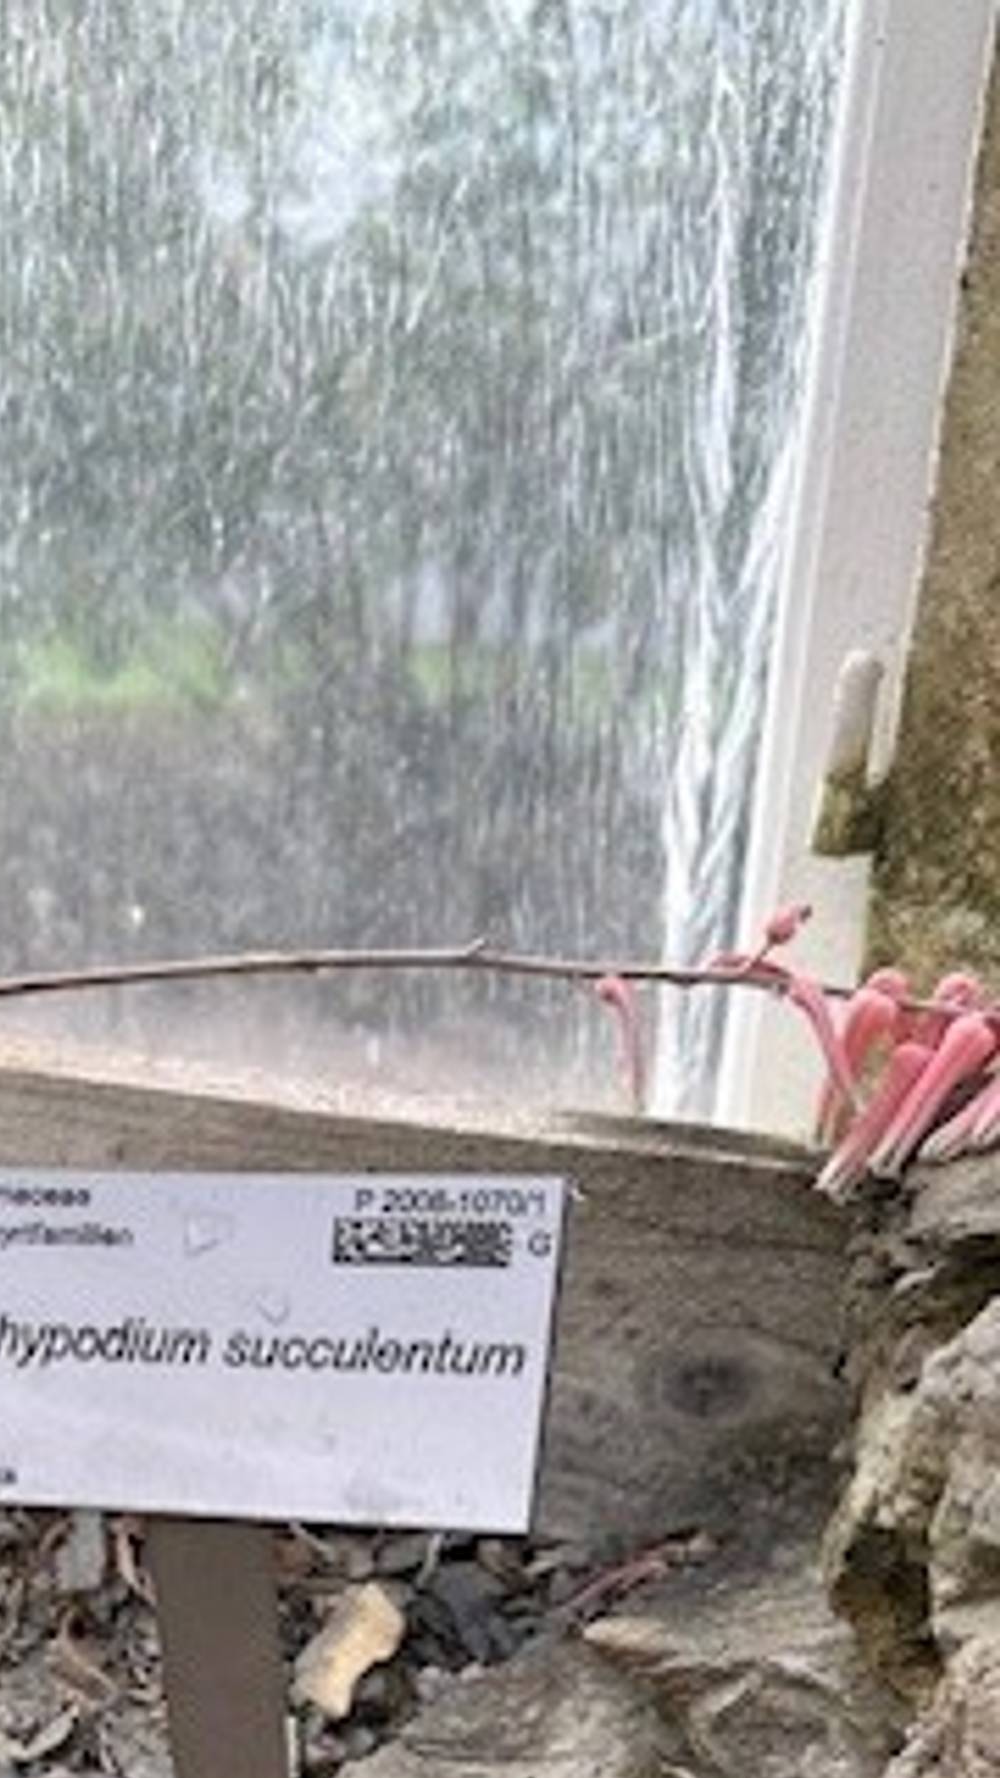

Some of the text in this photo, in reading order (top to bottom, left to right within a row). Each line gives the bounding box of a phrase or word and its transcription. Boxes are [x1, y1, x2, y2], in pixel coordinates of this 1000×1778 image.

[355, 1189, 373, 1211] P
[527, 1230, 552, 1257] G
[222, 1327, 526, 1377] succulentum
